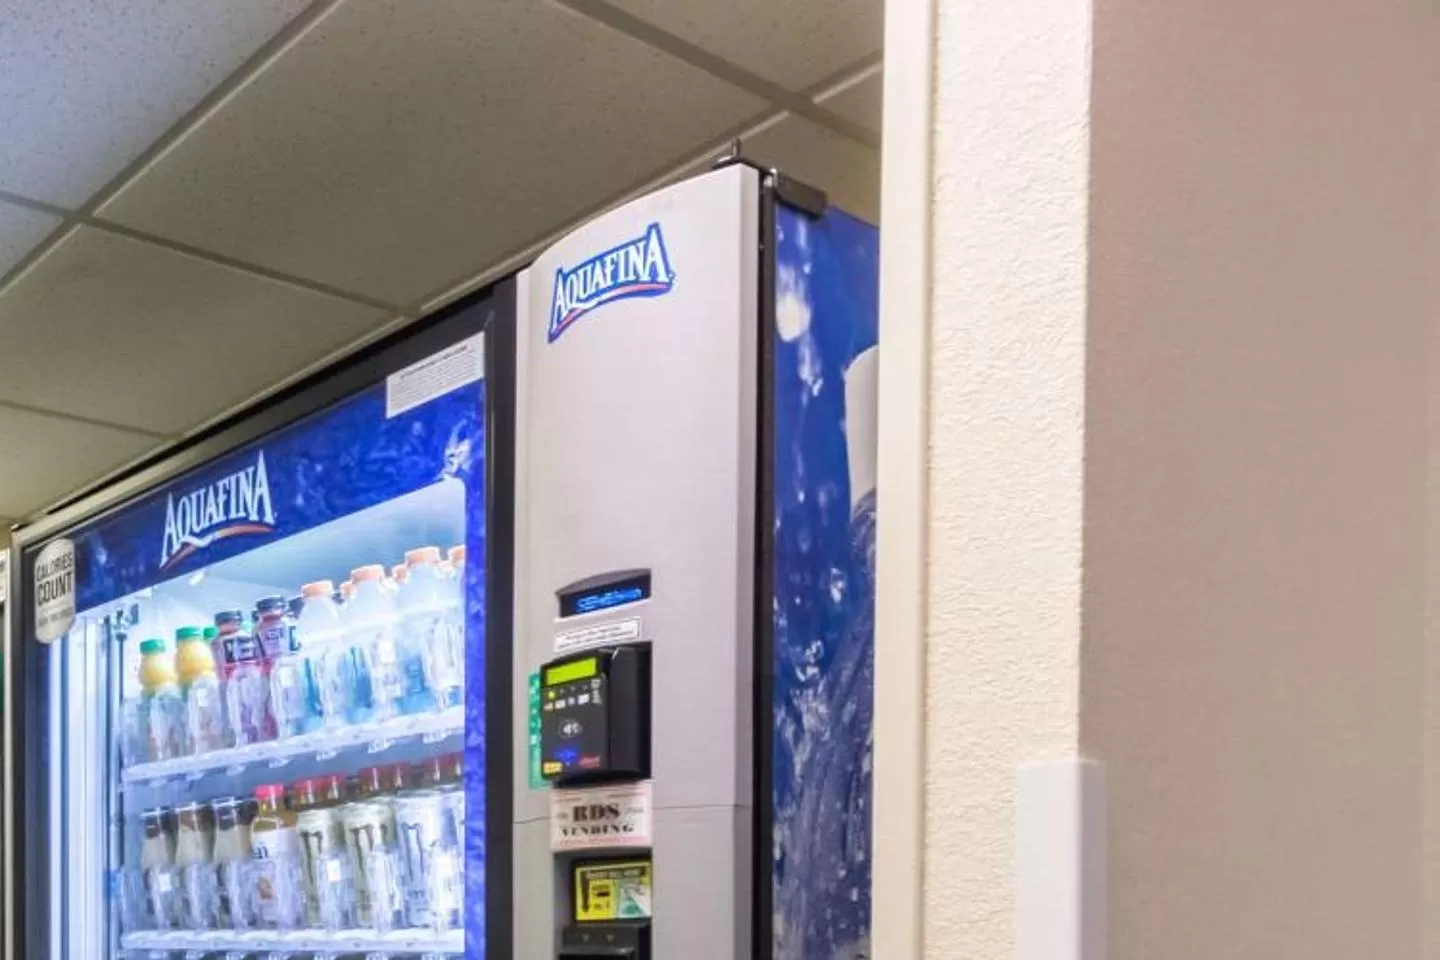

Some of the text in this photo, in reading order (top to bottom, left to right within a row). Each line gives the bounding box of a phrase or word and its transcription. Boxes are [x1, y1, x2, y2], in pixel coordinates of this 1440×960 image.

[551, 223, 675, 337] AQUAFINA
[159, 448, 276, 568] AQUAFINA
[38, 571, 73, 606] COUNT
[573, 803, 620, 821] RDS
